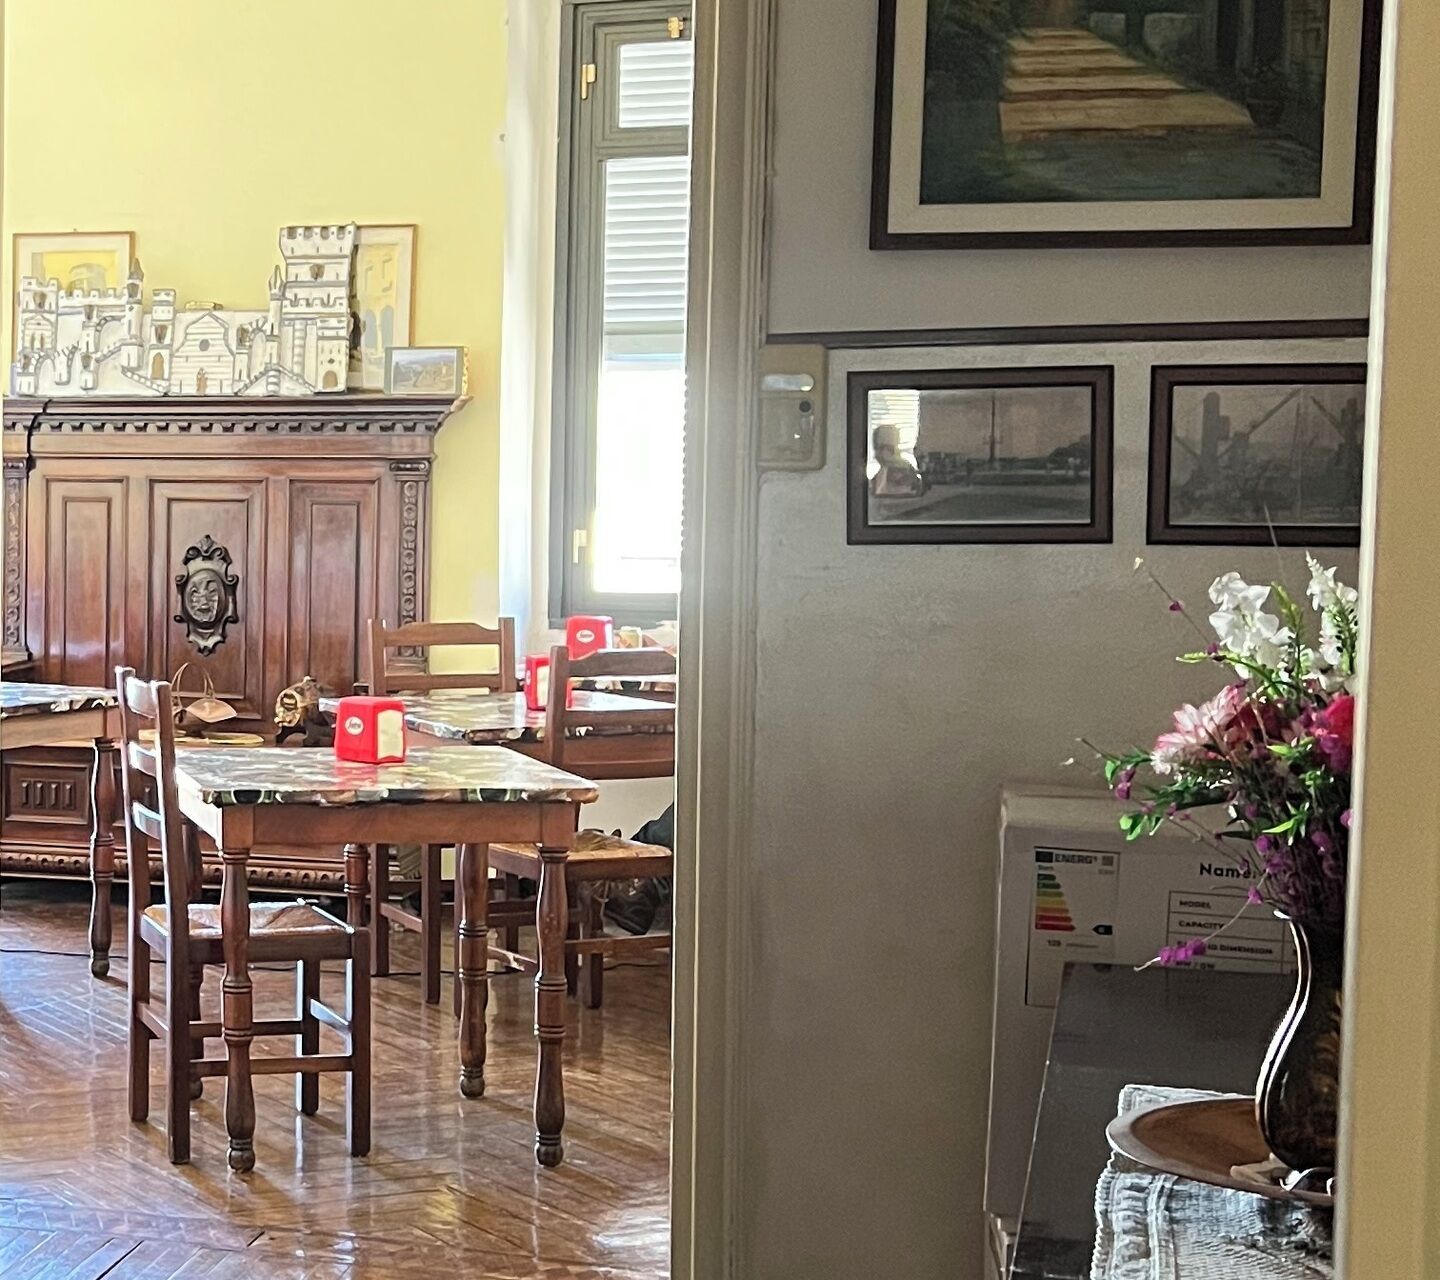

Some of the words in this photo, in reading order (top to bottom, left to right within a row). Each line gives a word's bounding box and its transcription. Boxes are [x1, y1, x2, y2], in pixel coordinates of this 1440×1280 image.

[1179, 900, 1212, 910] MODEL
[1178, 920, 1225, 930] CAPACITY
[1220, 944, 1273, 955] DIMENSION
